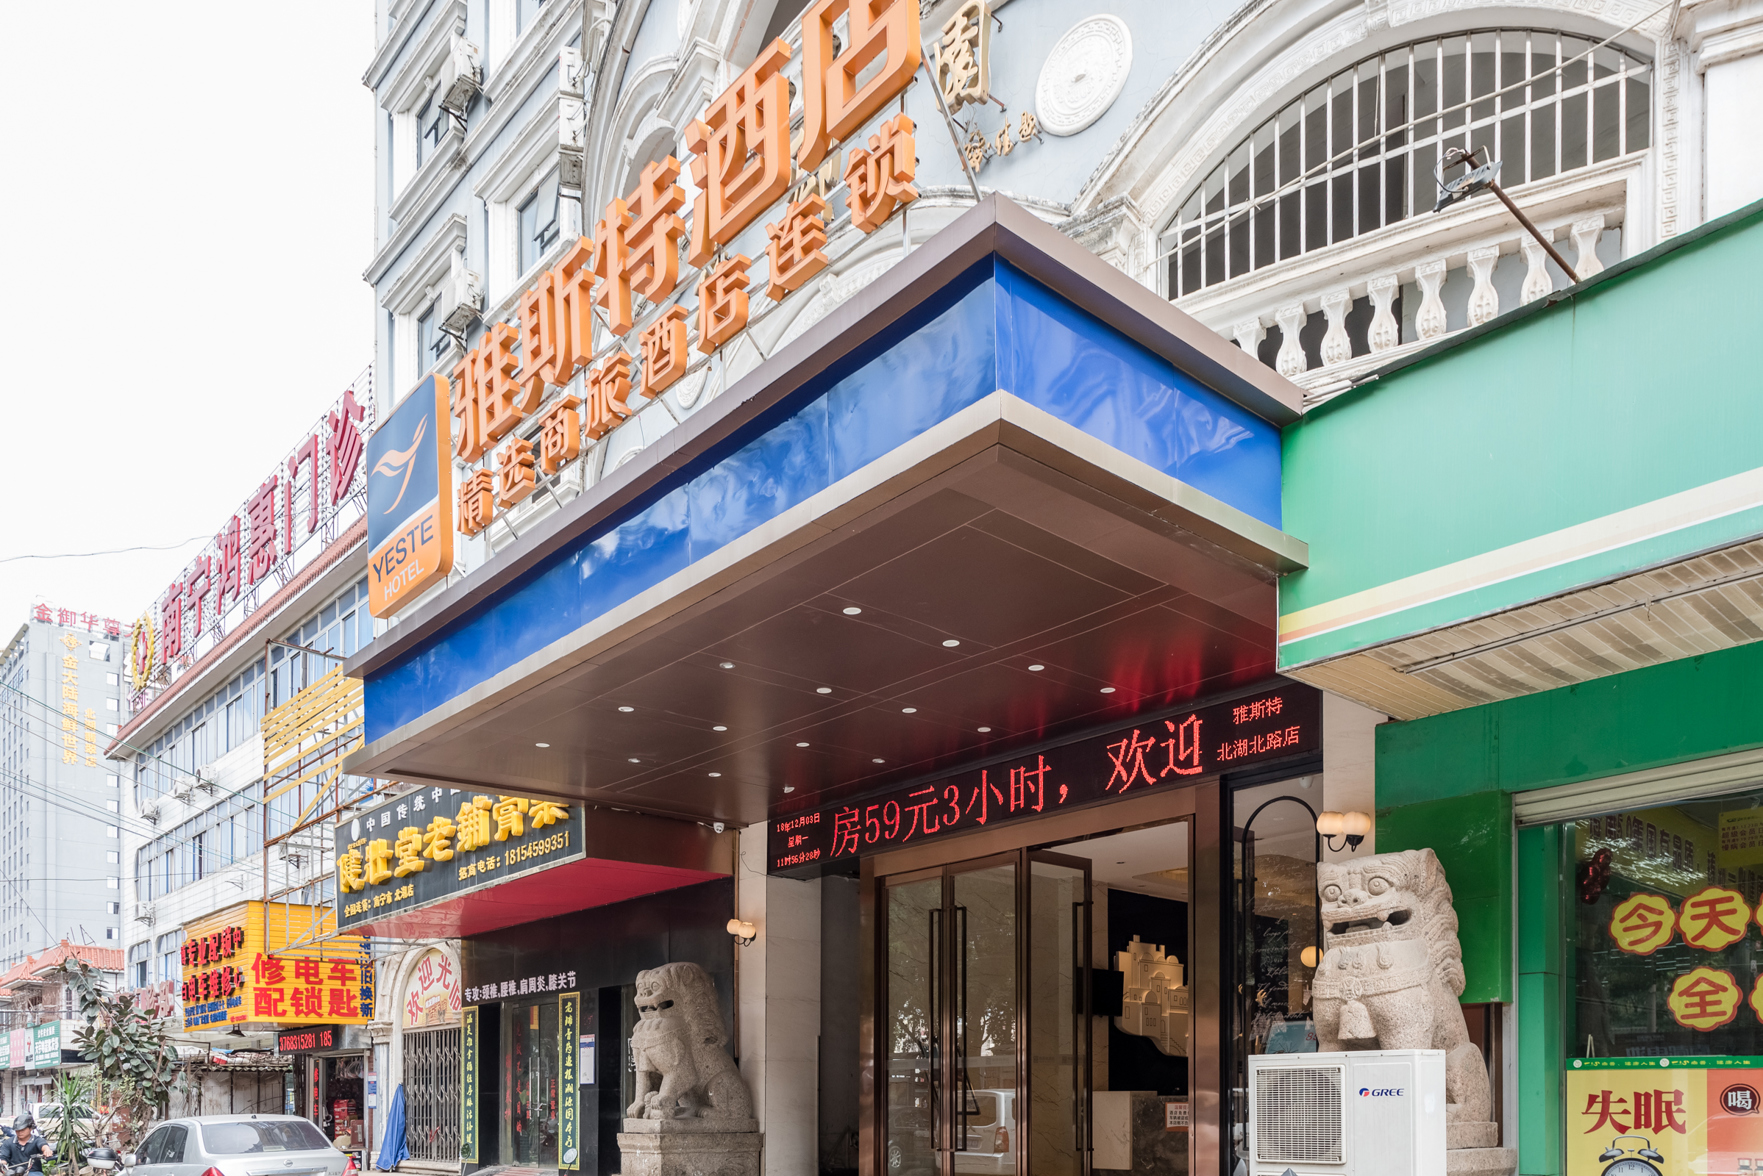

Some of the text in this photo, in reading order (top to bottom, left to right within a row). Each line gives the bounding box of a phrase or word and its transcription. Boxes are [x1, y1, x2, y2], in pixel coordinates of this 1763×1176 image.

[452, 0, 920, 463] 雅斯特酒店
[457, 112, 919, 537] 精选商旅酒店连锁
[372, 515, 434, 583] YESTE
[383, 559, 425, 601] HOTEL
[62, 654, 79, 766] 金大陆海鲜世界
[1232, 696, 1283, 725] 雅斯特
[1105, 713, 1204, 794] 欢迎
[1217, 725, 1301, 762] 北湖北路店
[777, 812, 820, 832] 18年12月03日
[788, 835, 809, 848] 星期一
[504, 830, 570, 866] 18154599351
[1619, 895, 1742, 947] 今天
[251, 952, 357, 986] 修电车
[253, 986, 359, 1018] 配锁匙
[406, 954, 461, 1026] 欢迎光临
[1677, 976, 1729, 1021] 全
[319, 1030, 333, 1048] 185
[1371, 1088, 1405, 1097] GREE
[1728, 1090, 1753, 1111] 喝
[1581, 1089, 1687, 1136] 失眠
